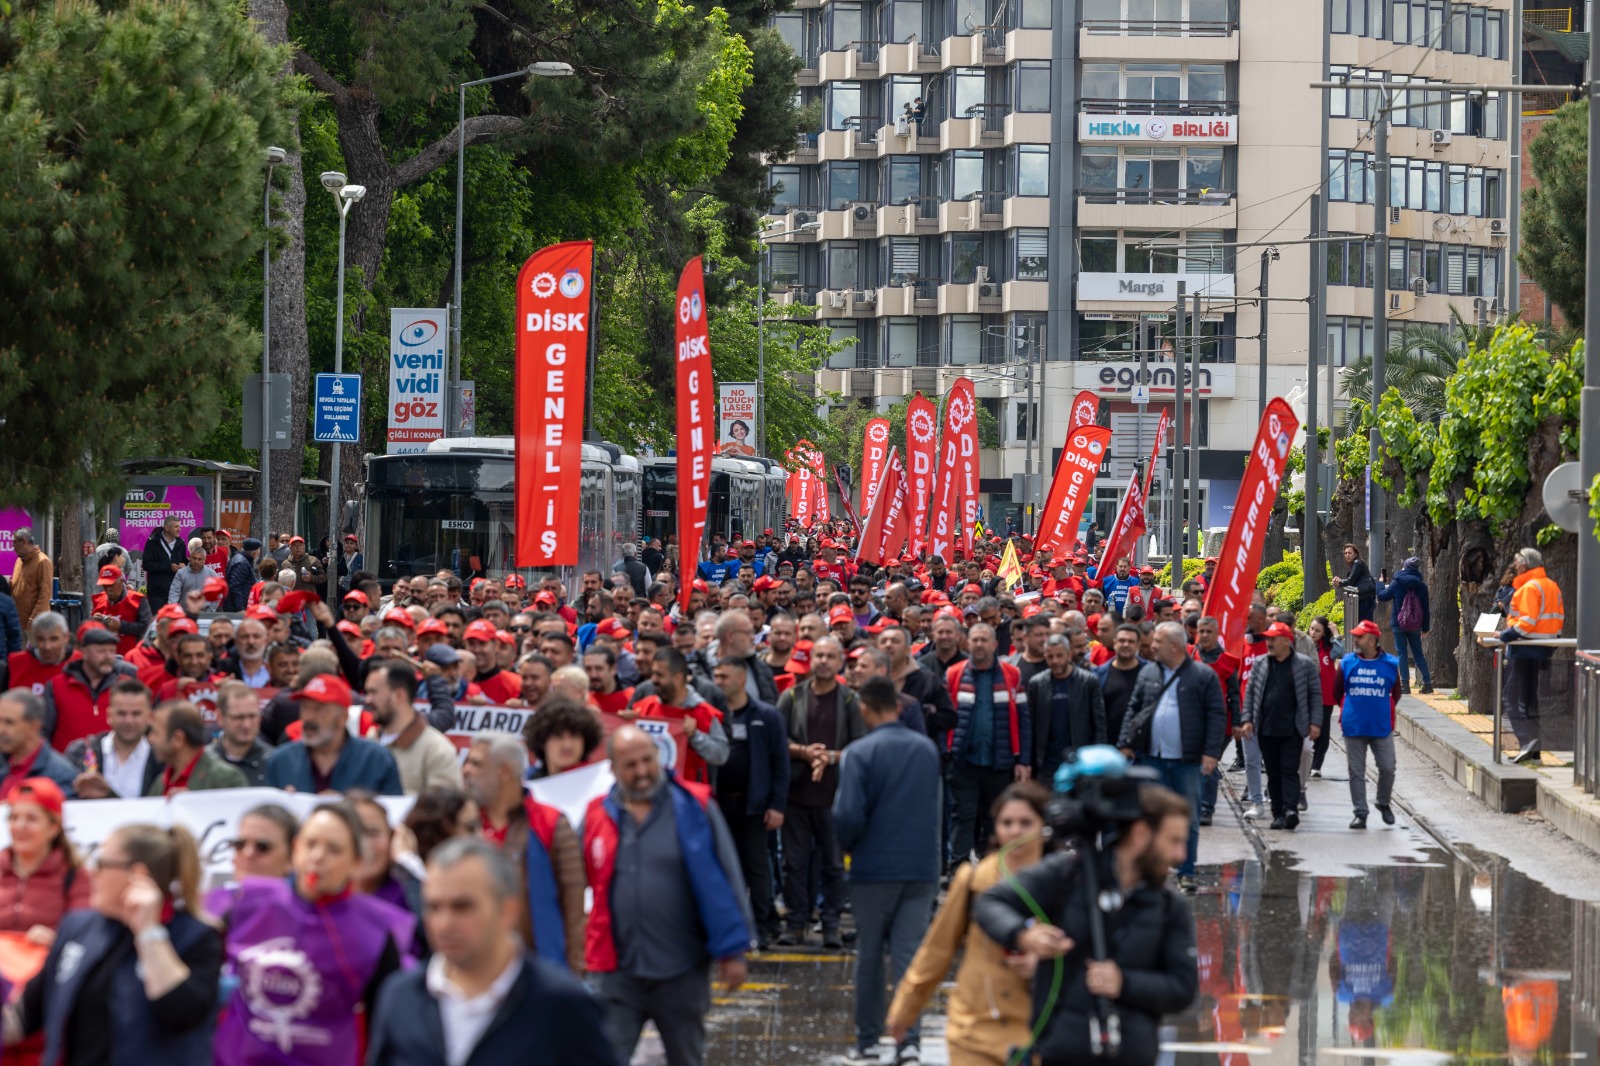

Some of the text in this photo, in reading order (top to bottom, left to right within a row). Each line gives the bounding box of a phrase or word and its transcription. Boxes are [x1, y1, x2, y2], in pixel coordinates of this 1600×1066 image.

[1089, 120, 1229, 137] HEKİM BİRLİĞİ
[1118, 280, 1164, 296] Marga
[526, 309, 585, 332] DİSK
[393, 349, 443, 370] veni
[678, 335, 708, 362] DİSK
[396, 373, 439, 394] vidi
[394, 397, 438, 423] göz
[389, 431, 409, 440] ÇİĞLİ
[541, 343, 567, 558] GENEL-İŞ
[688, 370, 707, 544] GENEL-
[1065, 451, 1098, 474] DİSK
[1050, 471, 1084, 546] GENEL-
[1349, 676, 1385, 686] GENEL-İŞ
[1357, 668, 1377, 676] DİSK
[1349, 686, 1386, 698] GÖREVLİ
[455, 709, 532, 733] NLARD
